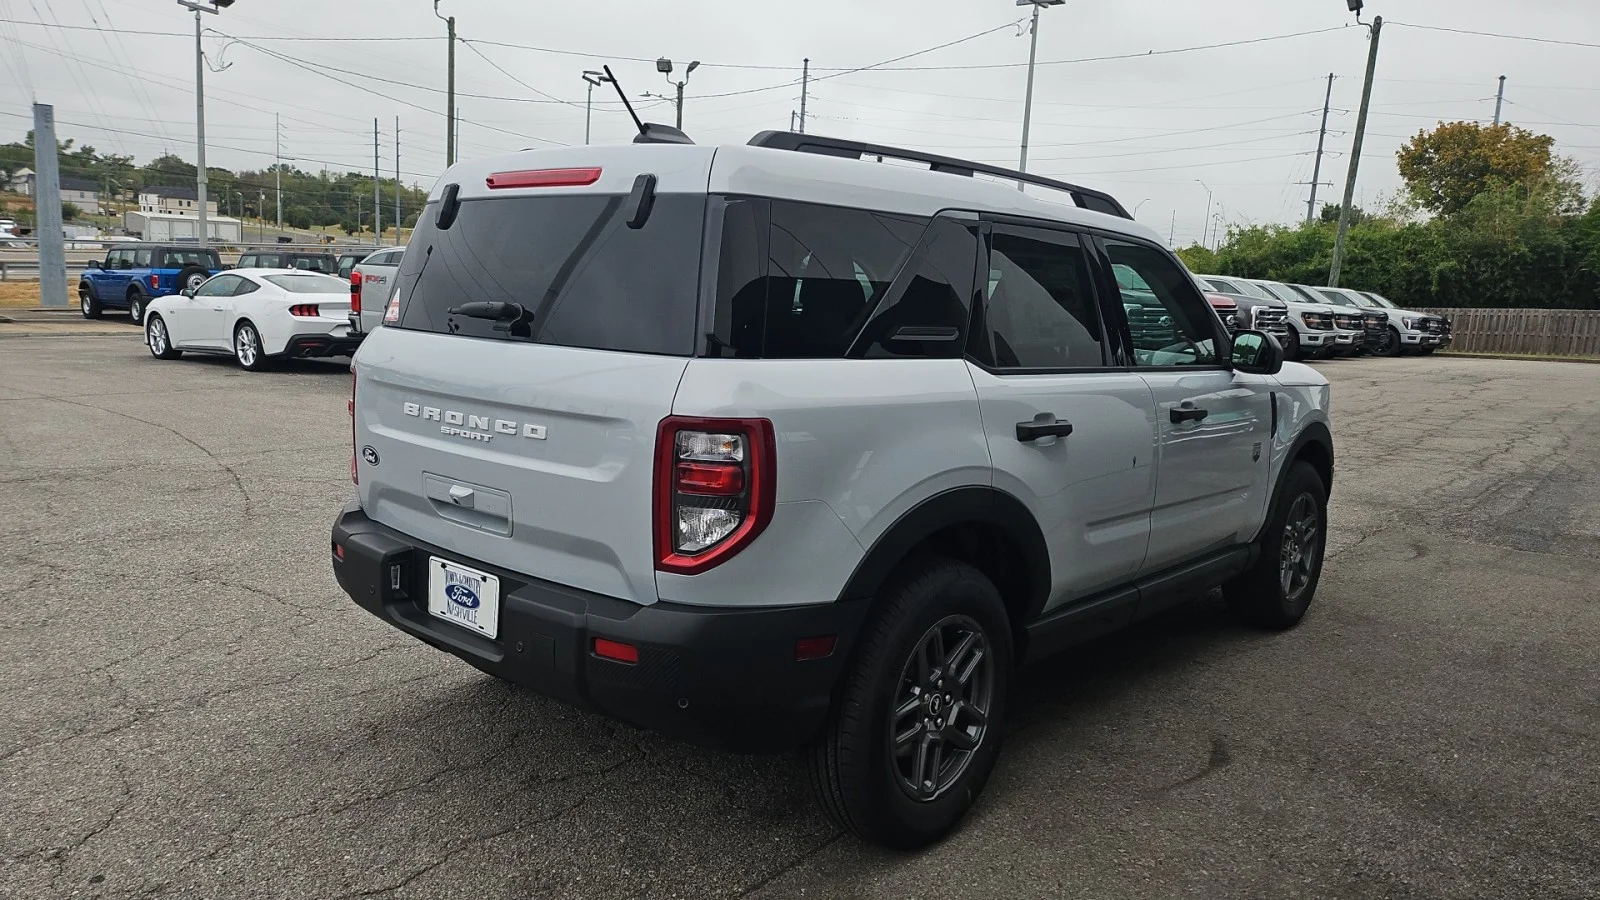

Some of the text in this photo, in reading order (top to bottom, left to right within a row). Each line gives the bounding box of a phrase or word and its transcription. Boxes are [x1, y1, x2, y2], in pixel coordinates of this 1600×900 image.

[404, 402, 547, 440] BRONCO
[440, 426, 493, 442] SPORT
[451, 586, 476, 606] Ford
